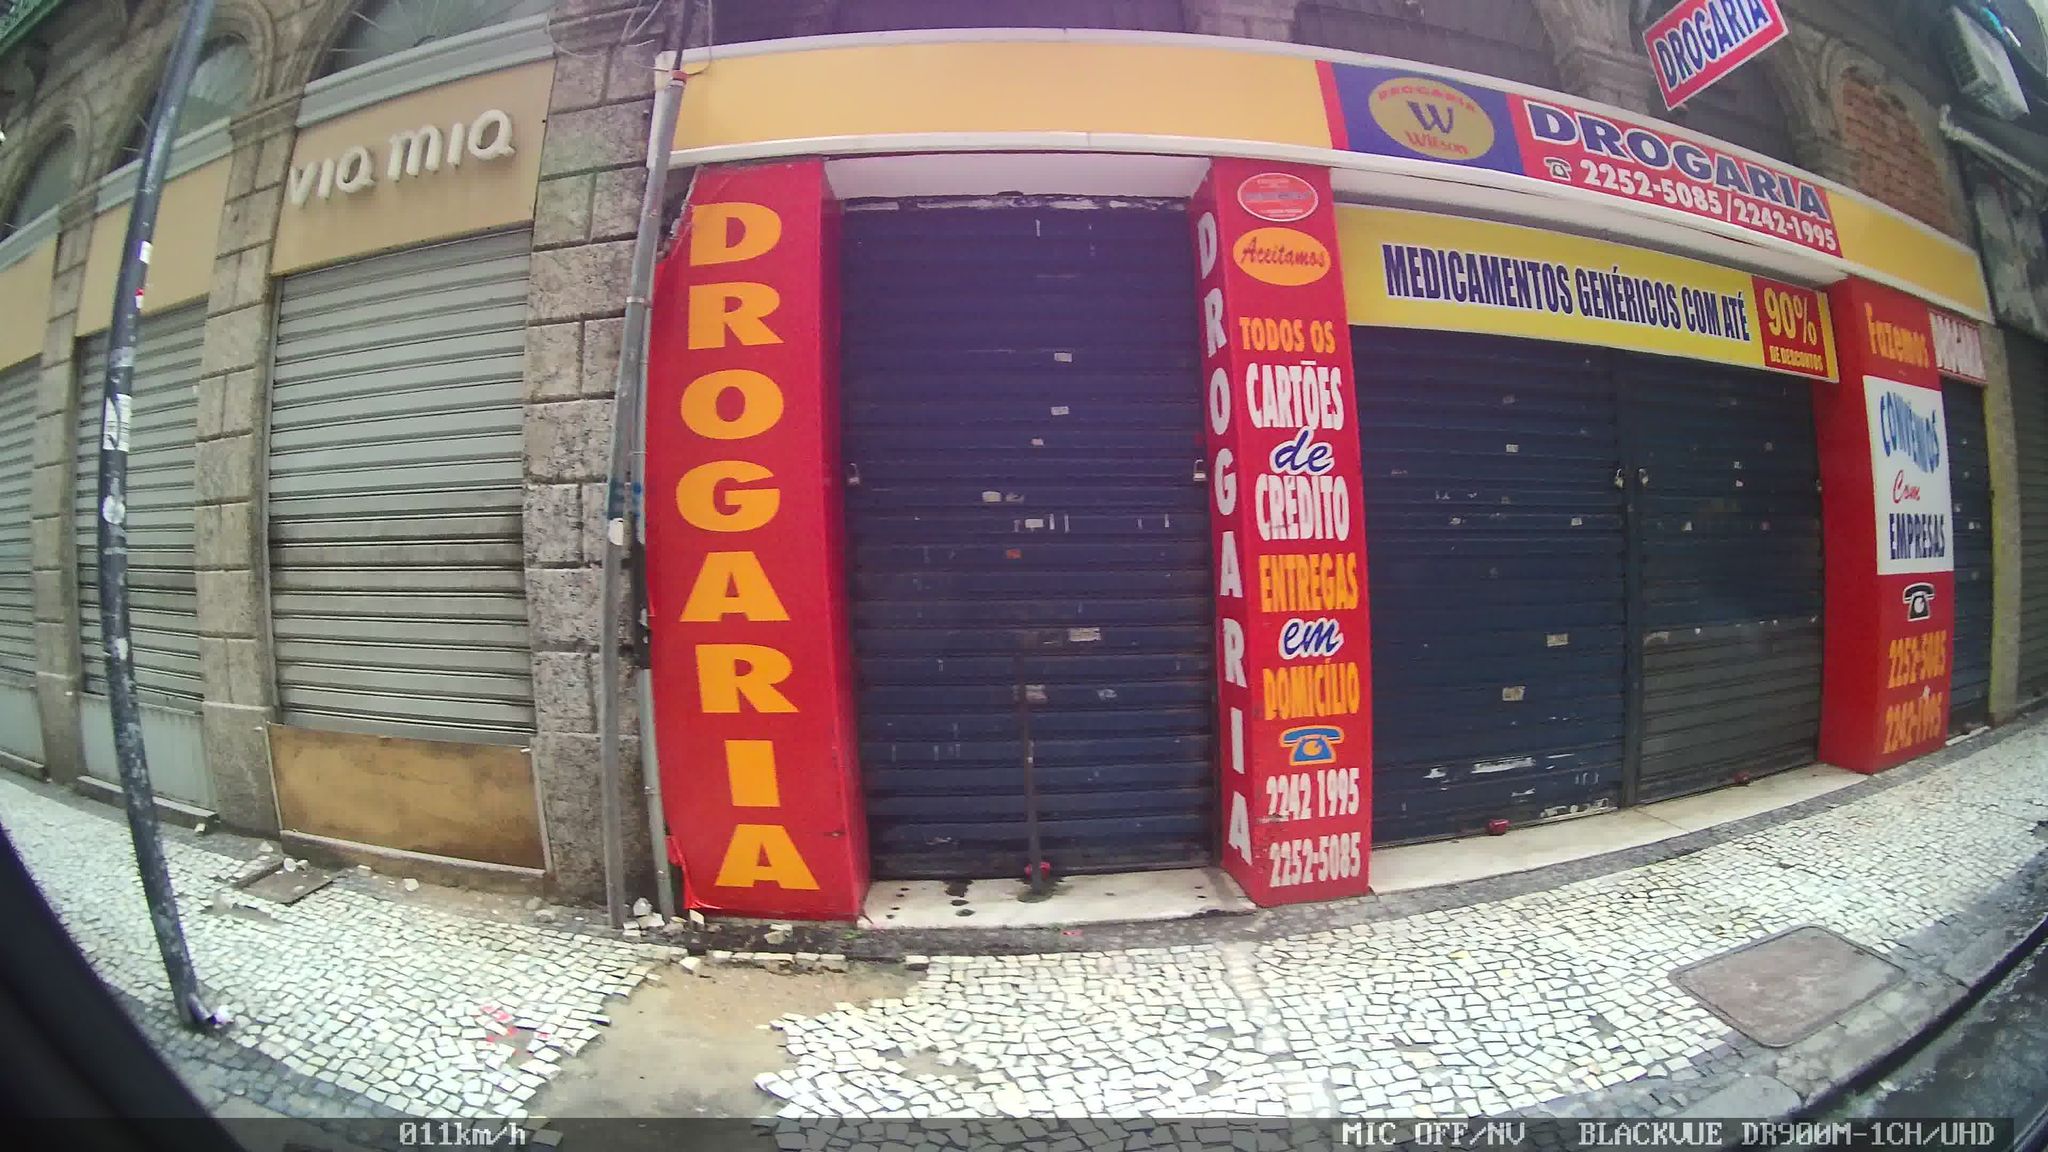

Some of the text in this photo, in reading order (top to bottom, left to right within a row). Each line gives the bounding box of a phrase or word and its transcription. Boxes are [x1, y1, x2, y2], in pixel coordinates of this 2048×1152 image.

[1655, 0, 1770, 90] DROGARIA
[1407, 100, 1455, 134] W
[1524, 99, 1831, 223] DROGARIA
[1241, 236, 1325, 268] Aceitamos
[1382, 243, 1752, 343] MEDICAMENTOS GENÉRICOS COM ATÉ
[1763, 287, 1818, 346] 90%
[1239, 317, 1336, 353] TODOS OS
[1245, 360, 1344, 431] CARTÕES
[1269, 427, 1335, 476] de
[676, 202, 820, 890] DROGARIA
[1197, 211, 1252, 866] DROGARIA
[1889, 513, 1946, 560] EMPRESAS
[1258, 553, 1360, 613] ENTREGAS
[1278, 617, 1344, 660] em
[1262, 659, 1360, 721] DOMICÍLIO
[1266, 768, 1360, 823] 2242 1995
[1269, 832, 1361, 888] 2252-5085
